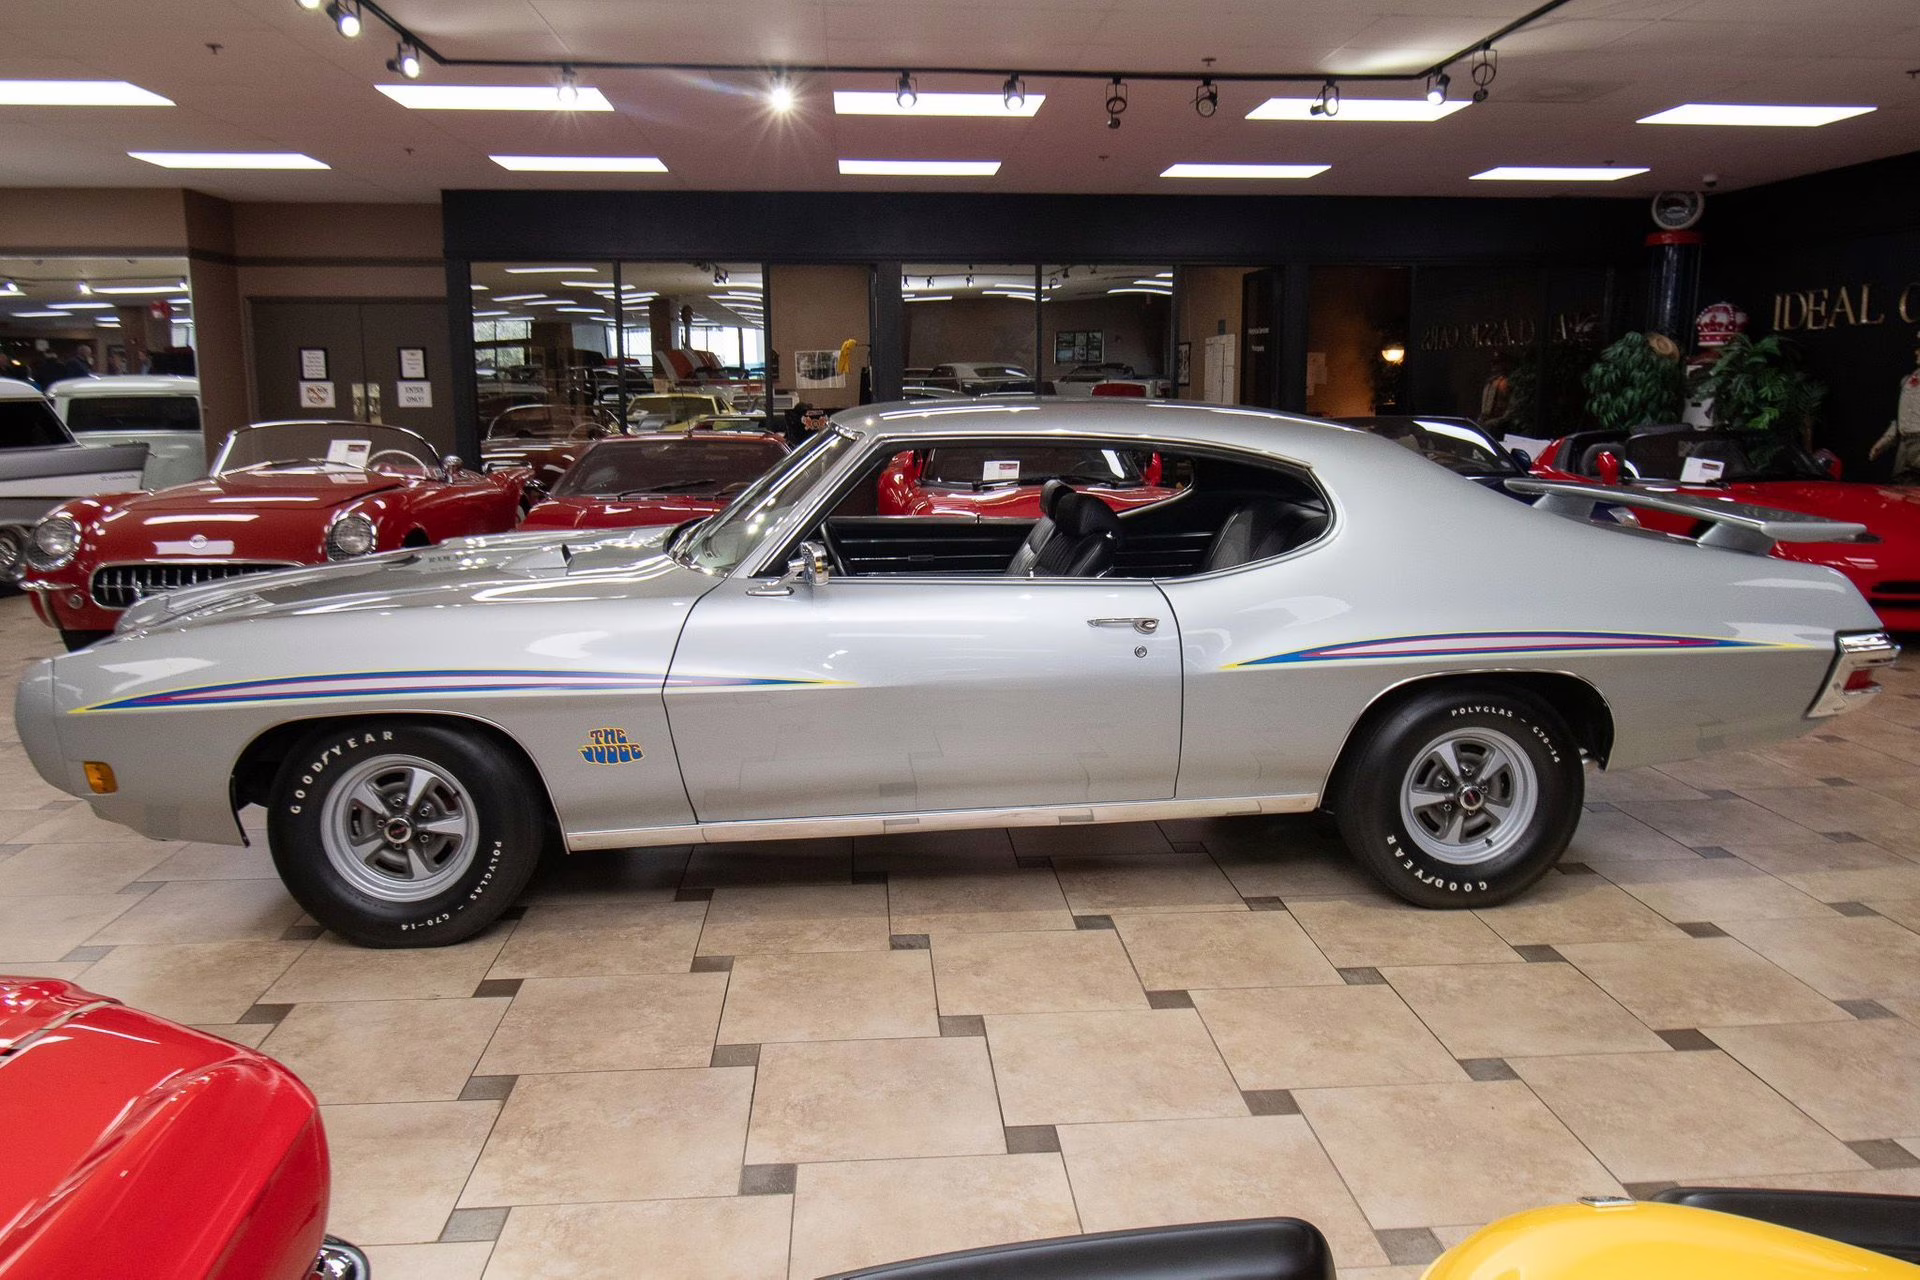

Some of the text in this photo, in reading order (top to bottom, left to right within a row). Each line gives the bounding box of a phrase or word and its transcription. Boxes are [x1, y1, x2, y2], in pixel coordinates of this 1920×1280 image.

[1773, 284, 1885, 331] IDEAL
[1451, 706, 1513, 718] POLYGLAS
[578, 743, 646, 765] JUDGE
[588, 728, 629, 745] THE
[290, 731, 393, 814] GOODYEAR
[470, 841, 502, 900] POLYGLAS
[1386, 835, 1487, 892] GOODYEAR
